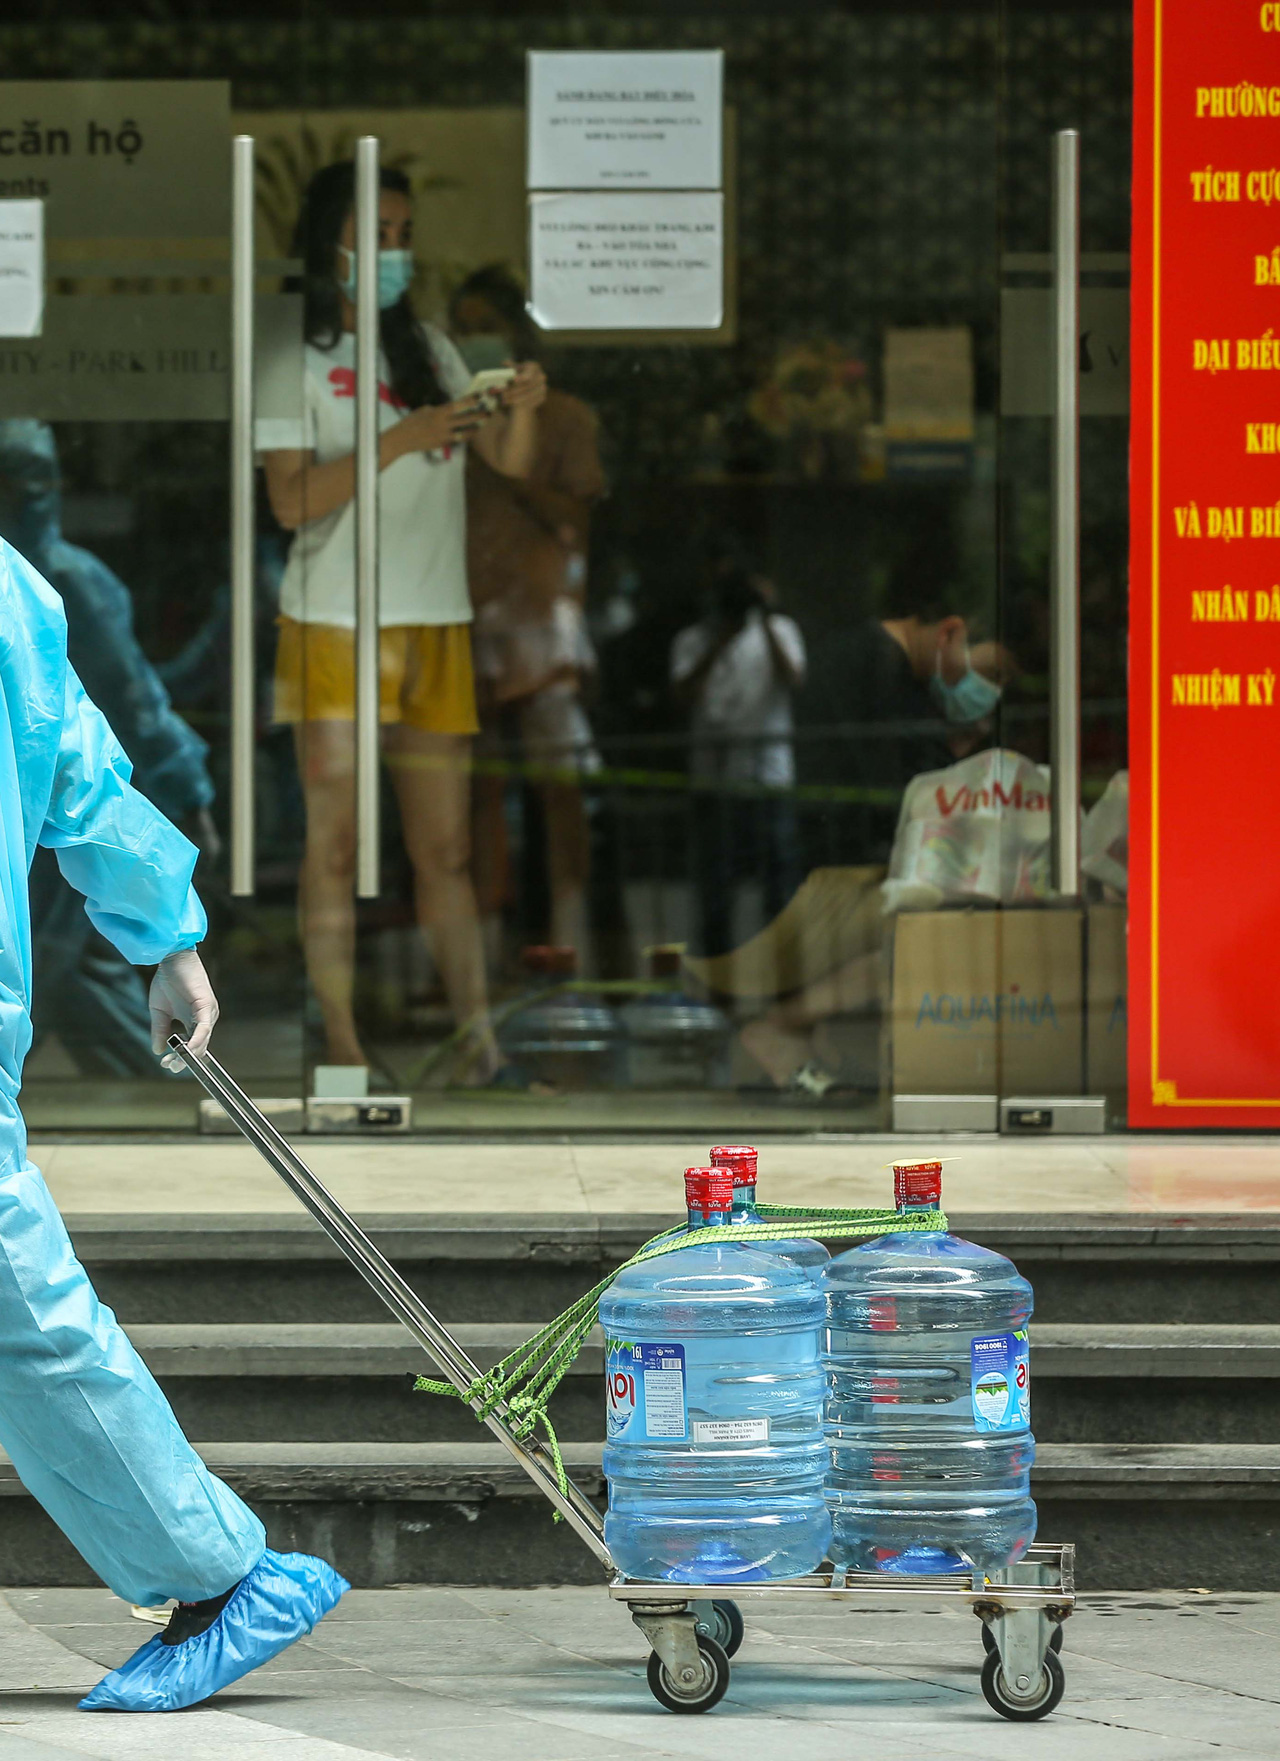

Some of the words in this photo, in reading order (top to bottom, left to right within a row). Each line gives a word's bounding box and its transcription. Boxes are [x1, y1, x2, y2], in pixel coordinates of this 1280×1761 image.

[88, 121, 143, 163] hộ
[1190, 165, 1240, 201] TÍCH
[70, 350, 147, 374] PARK
[1193, 339, 1230, 375] ĐẠI
[1174, 500, 1202, 538] VÀ
[1207, 507, 1244, 543] ĐẠI
[1191, 584, 1248, 622] NHÂN
[1172, 667, 1240, 711] NHIỆM
[914, 992, 1063, 1033] AQUAFINA
